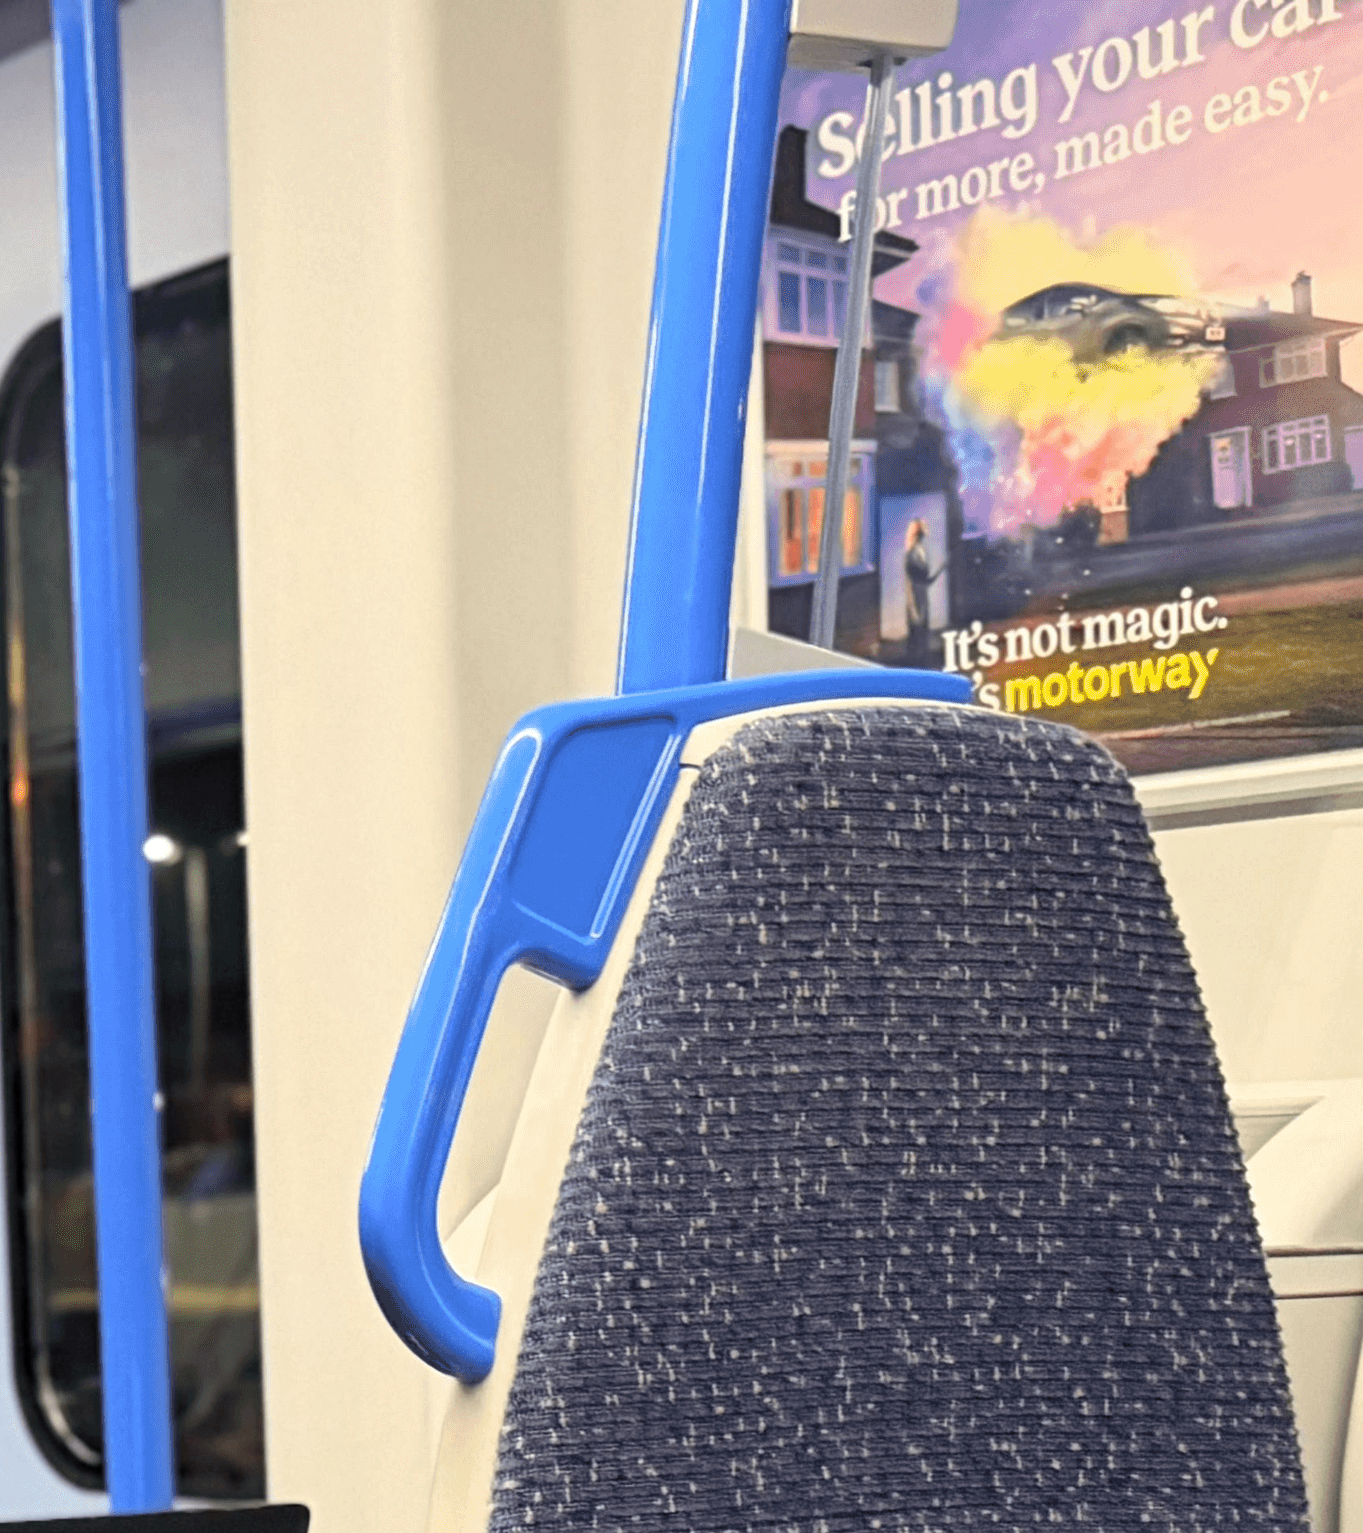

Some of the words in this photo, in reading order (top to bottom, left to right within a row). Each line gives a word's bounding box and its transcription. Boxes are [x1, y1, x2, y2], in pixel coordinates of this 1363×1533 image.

[818, 63, 1039, 179] Selling
[1051, 4, 1215, 124] your
[915, 152, 1046, 220] more,
[1053, 100, 1193, 180] made
[1204, 65, 1330, 134] easy.
[941, 620, 1000, 673] It's
[1004, 612, 1076, 663] not
[1082, 586, 1229, 651] magic.
[1005, 648, 1219, 713] motorway
